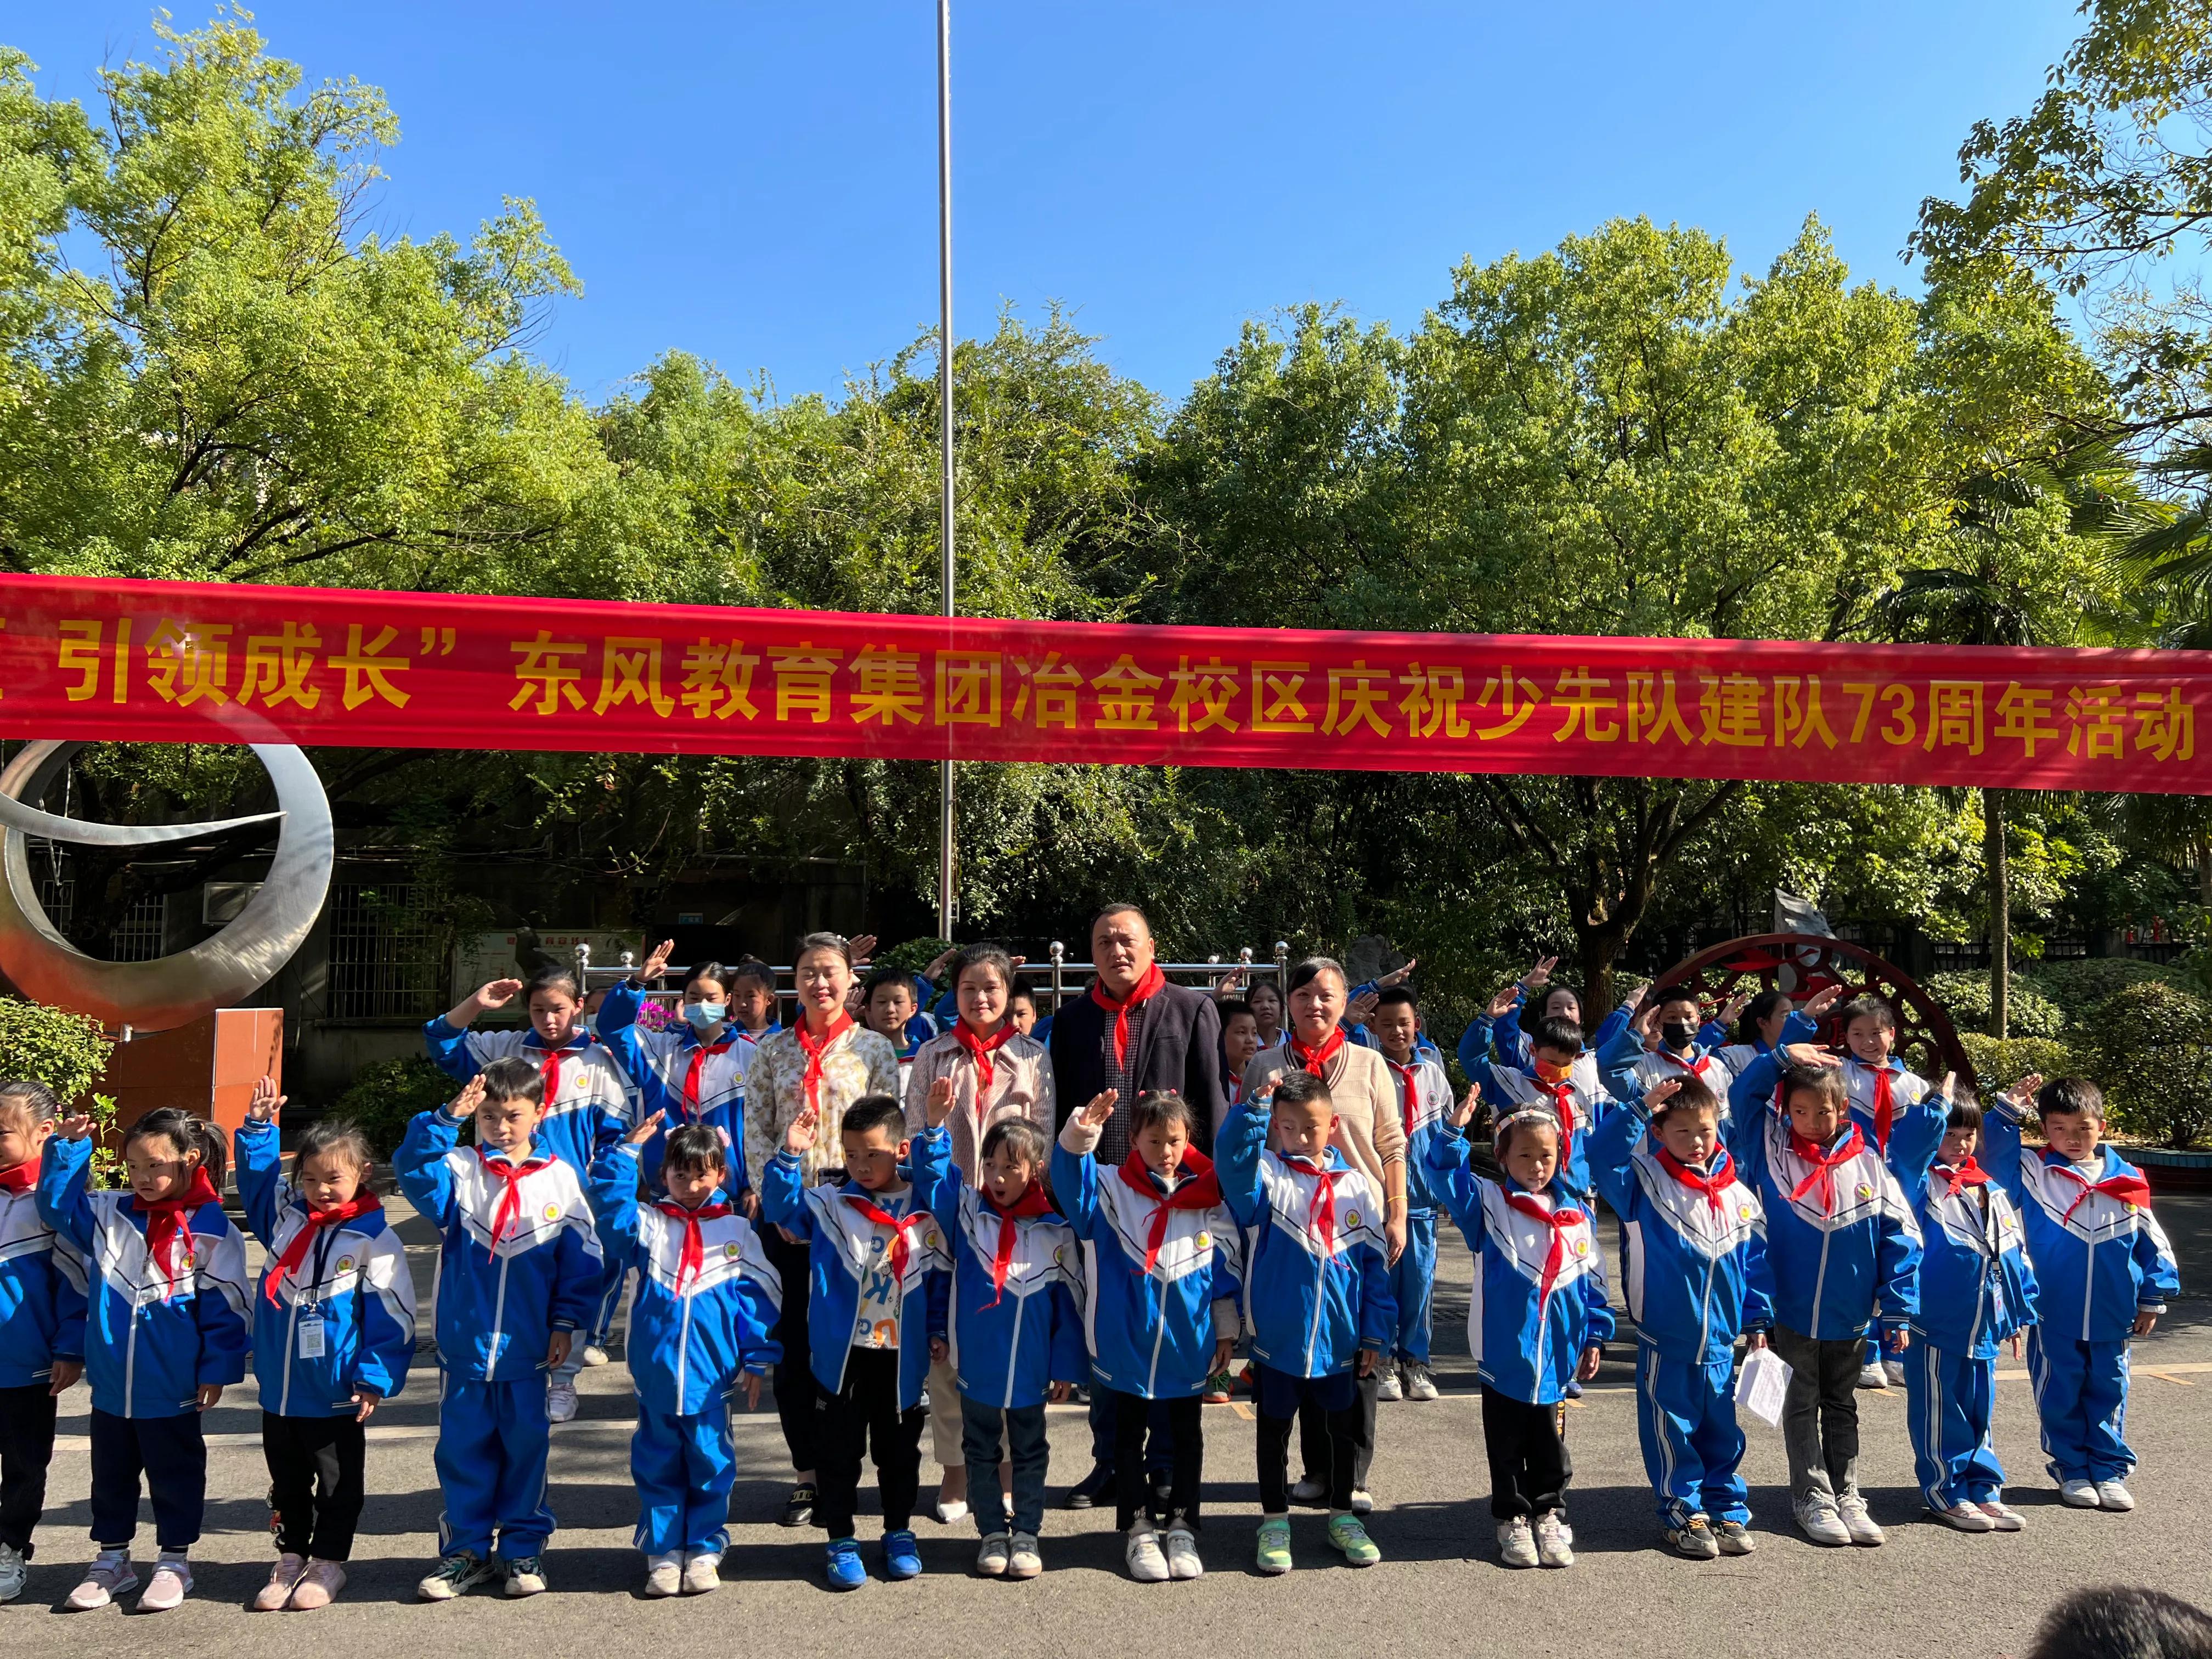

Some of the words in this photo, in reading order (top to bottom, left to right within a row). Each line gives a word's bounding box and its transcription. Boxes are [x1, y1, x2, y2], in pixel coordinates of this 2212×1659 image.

[508, 630, 2194, 762] 东风教育集团冶金校区庆祝少先队建队73周年活动
